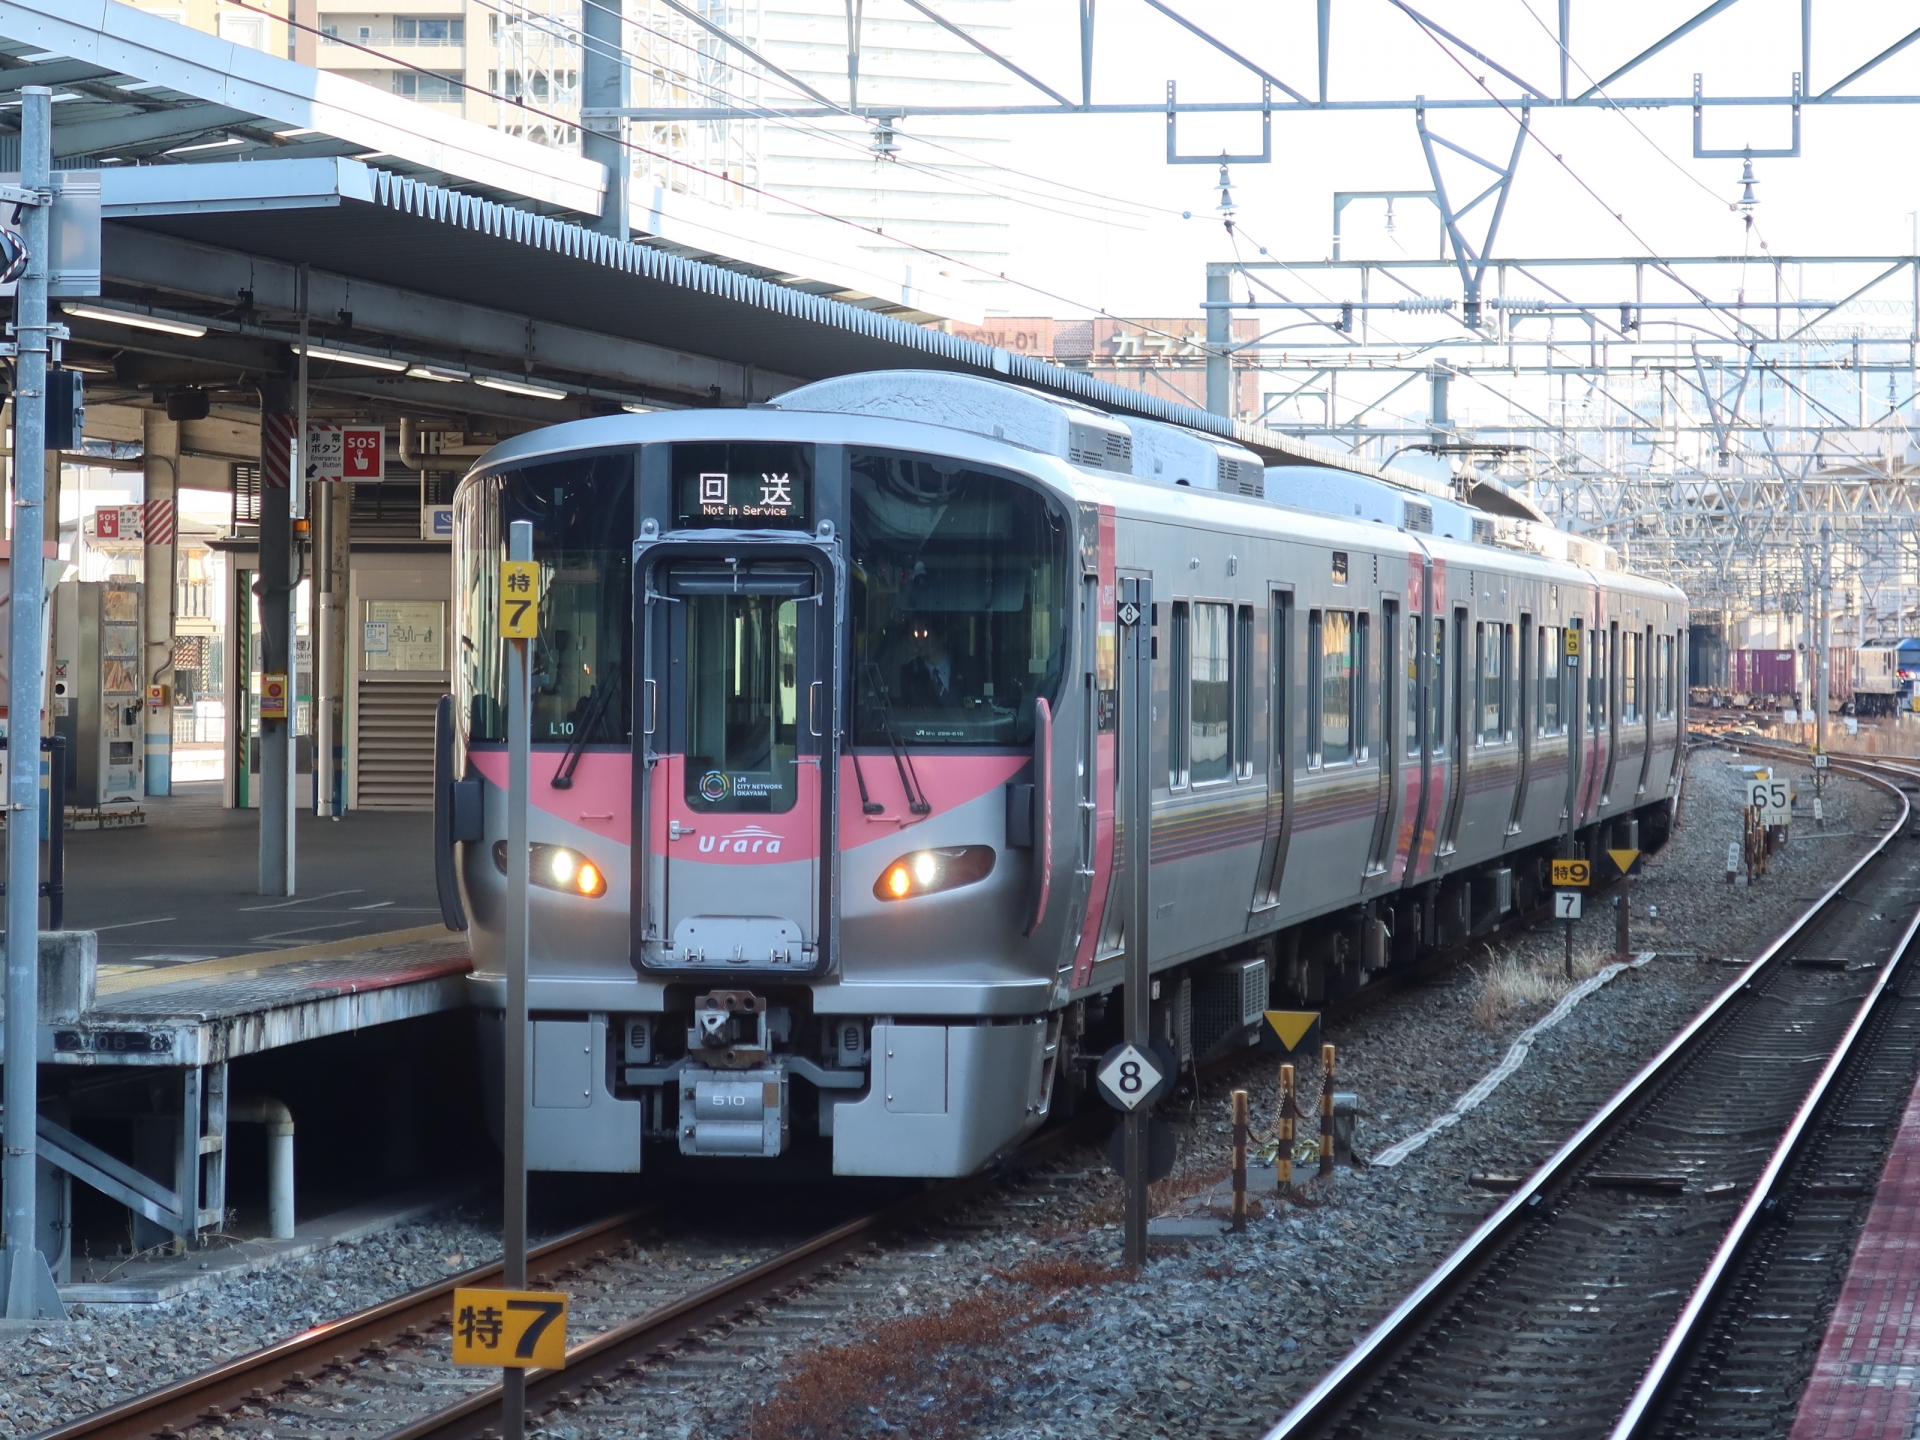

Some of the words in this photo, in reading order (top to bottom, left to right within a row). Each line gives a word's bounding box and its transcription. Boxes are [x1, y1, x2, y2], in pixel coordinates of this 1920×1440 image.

[311, 433, 341, 443] 非常
[348, 437, 376, 448] SOS
[311, 443, 341, 453] ボタン
[699, 472, 792, 506] 回送
[703, 504, 724, 515] Not
[729, 504, 738, 515] in
[743, 504, 787, 516] Service
[99, 513, 116, 521] SOS
[1126, 605, 1133, 621] 8
[550, 722, 574, 735] L10
[1752, 783, 1786, 809] 65
[698, 835, 781, 854] Urara
[1562, 896, 1575, 915] 7
[1119, 1061, 1143, 1094] 8
[712, 1095, 745, 1106] 510
